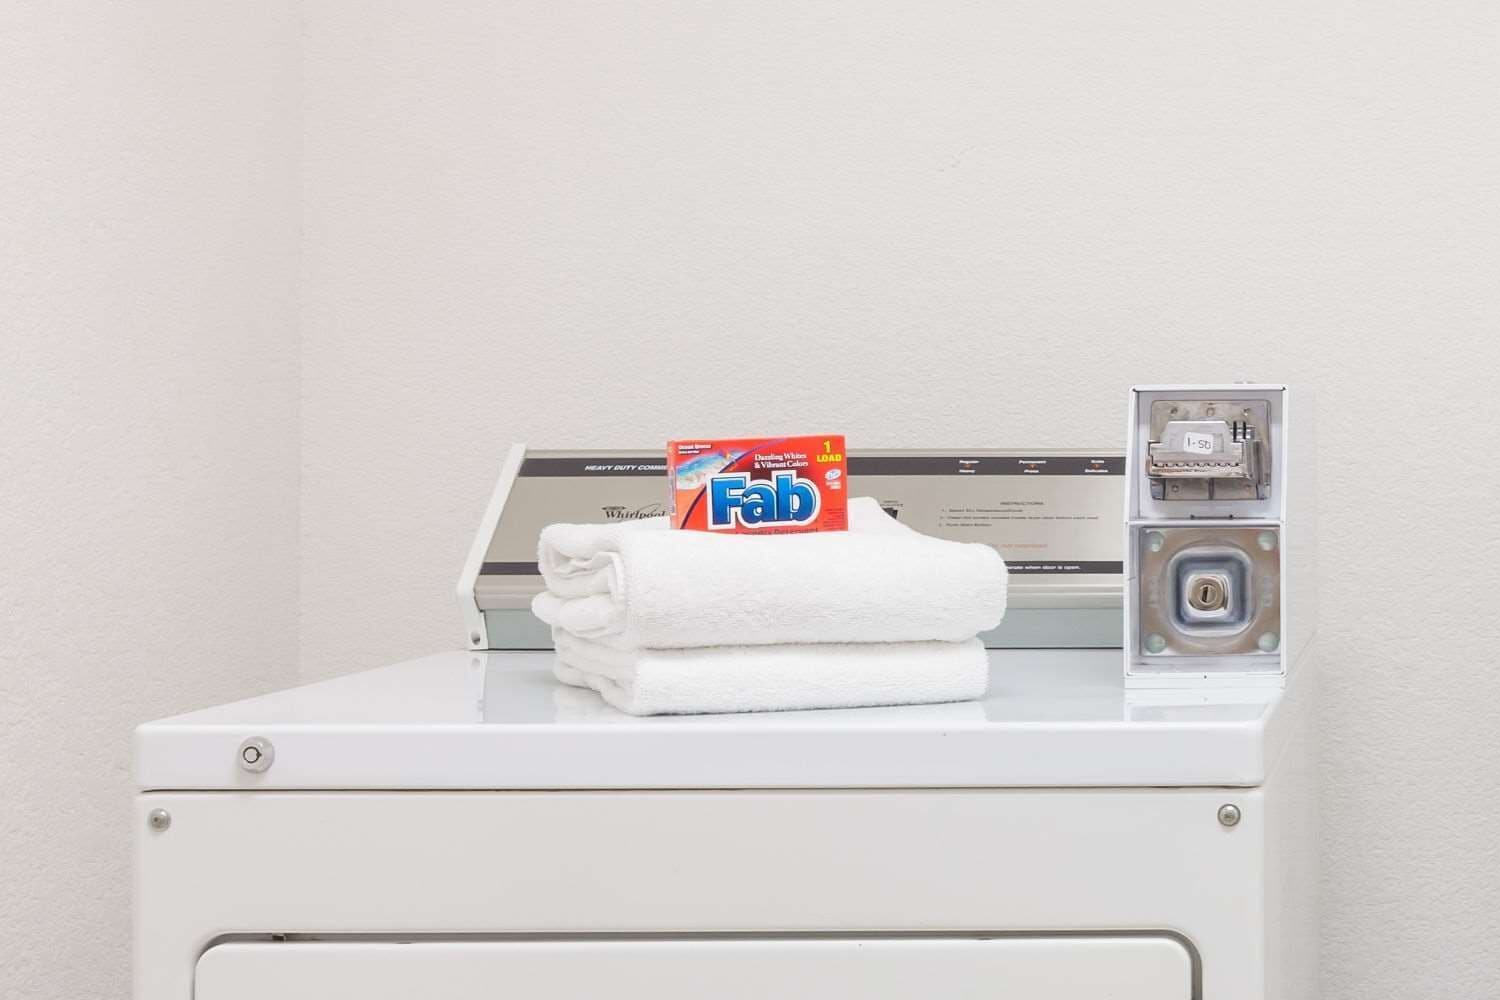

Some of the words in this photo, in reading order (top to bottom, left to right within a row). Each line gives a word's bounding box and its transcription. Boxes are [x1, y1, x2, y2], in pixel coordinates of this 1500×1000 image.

[823, 441, 832, 453] 1
[755, 453, 783, 461] Dazzling
[816, 454, 842, 463] LOAD
[754, 461, 761, 469] &
[761, 461, 786, 469] Vibrant
[709, 471, 820, 529] Fab
[605, 510, 666, 520] Whirlpool
